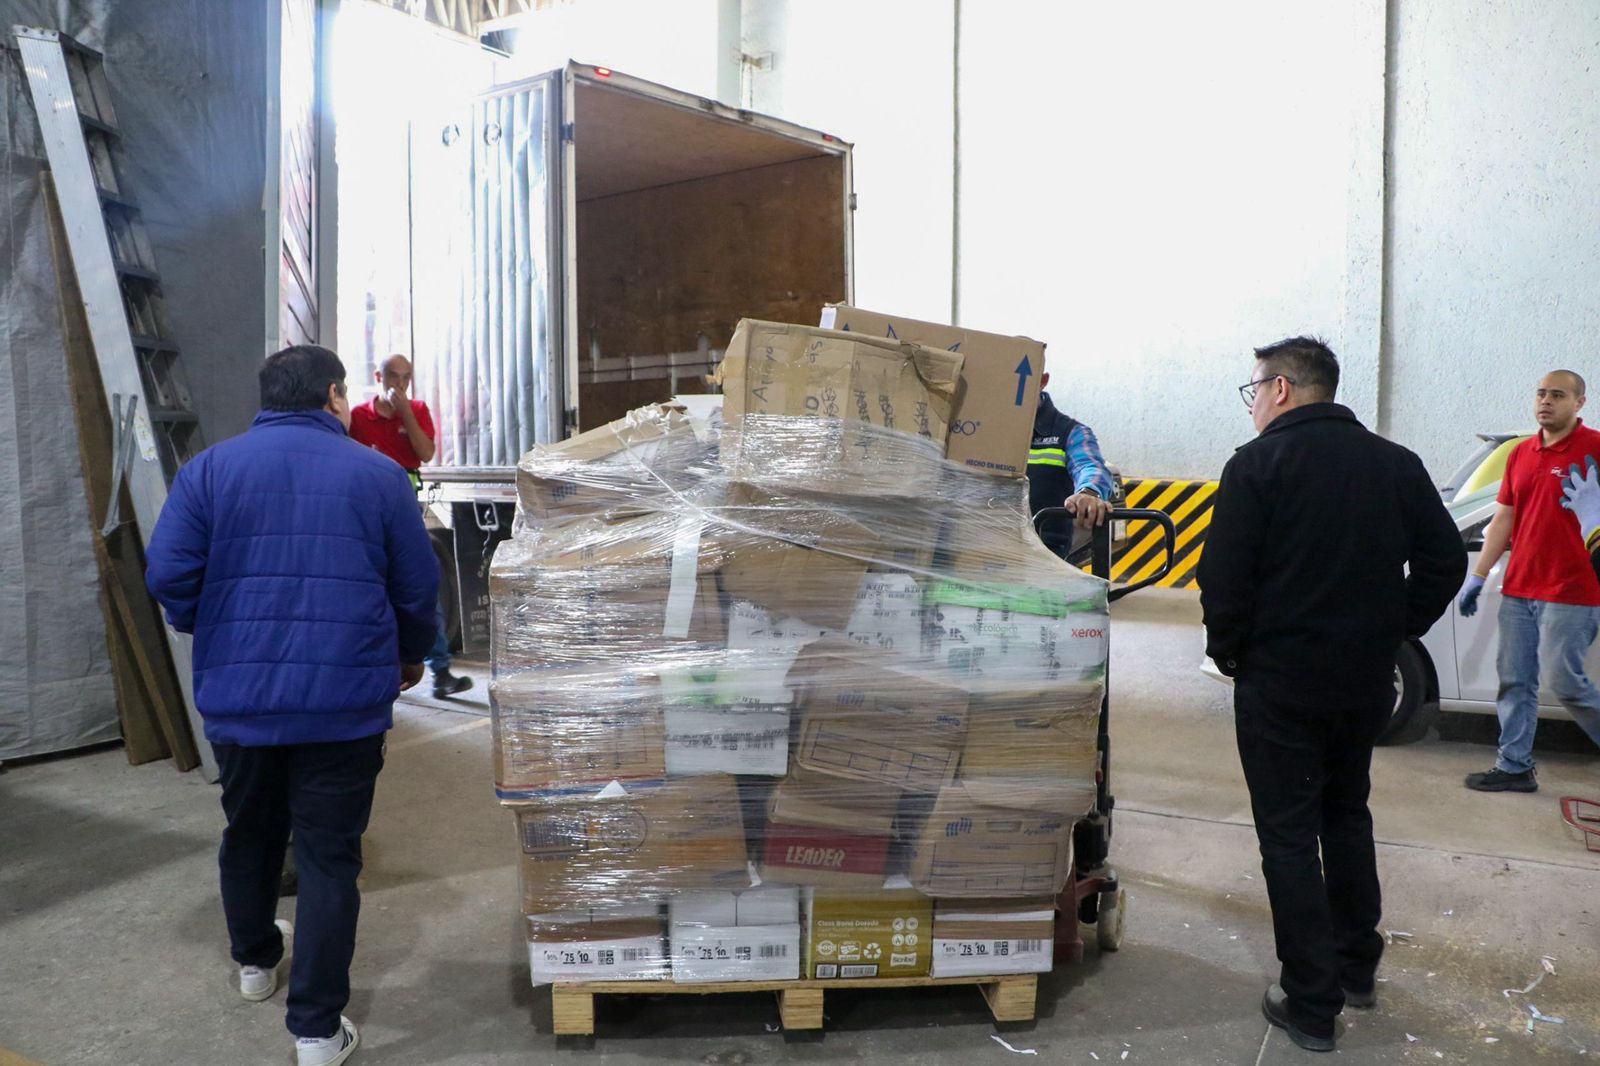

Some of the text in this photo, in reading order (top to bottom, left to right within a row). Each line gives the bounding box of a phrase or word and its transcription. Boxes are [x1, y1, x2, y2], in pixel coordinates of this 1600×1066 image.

[965, 458, 985, 468] HECHO
[987, 461, 995, 469] EN
[1071, 626, 1103, 639] xerox
[785, 845, 847, 867] LEADER
[703, 948, 712, 957] 75
[717, 948, 726, 957] 10
[962, 944, 972, 954] 75
[976, 944, 986, 953] 10
[564, 952, 574, 962] 75
[579, 952, 589, 962] 10
